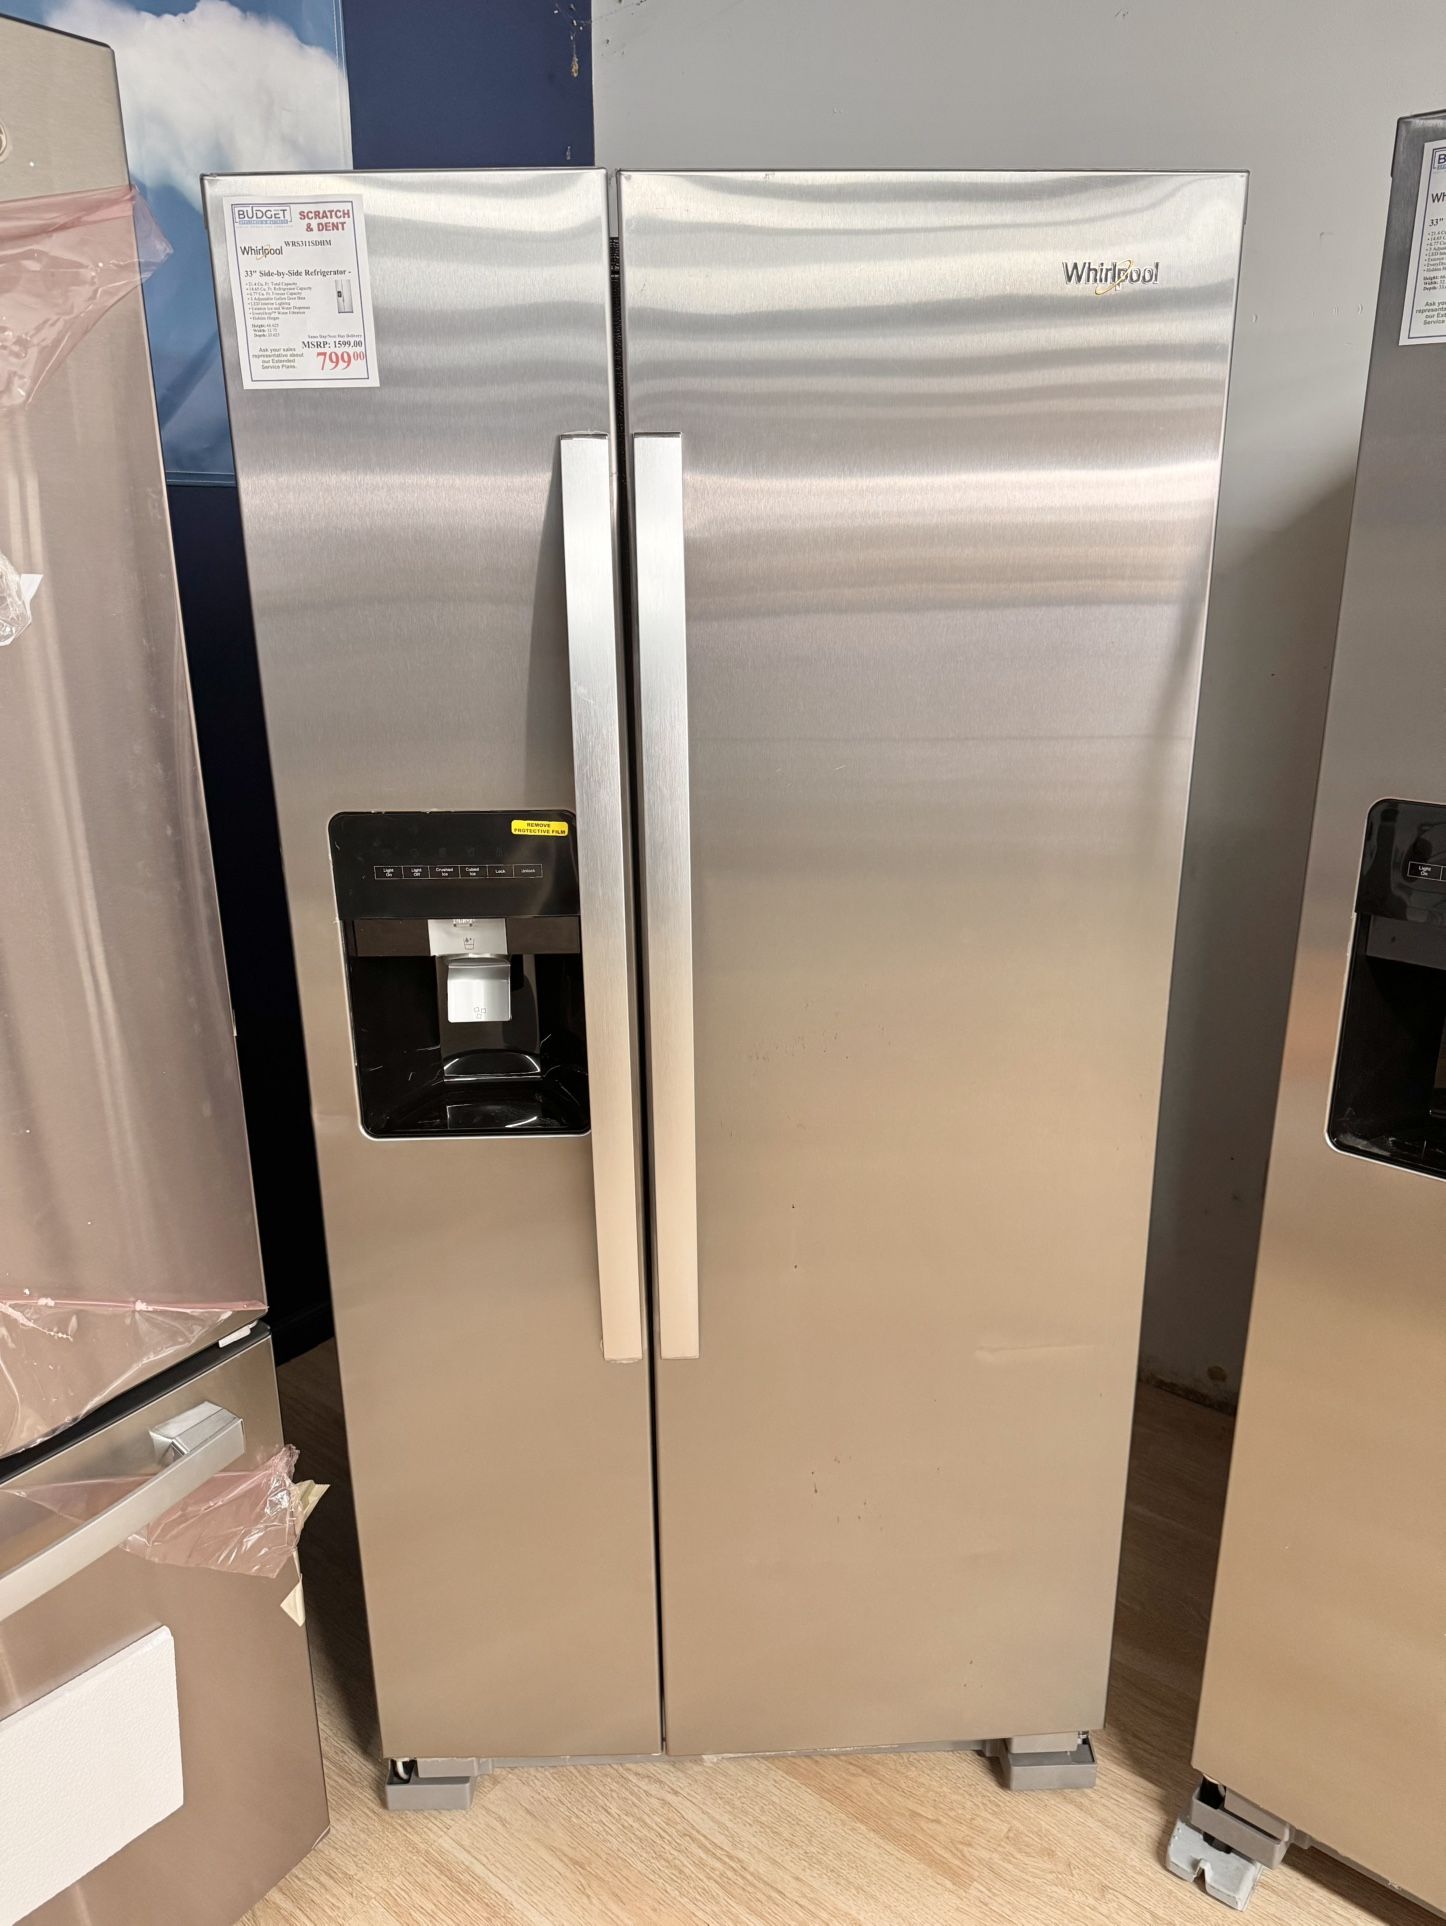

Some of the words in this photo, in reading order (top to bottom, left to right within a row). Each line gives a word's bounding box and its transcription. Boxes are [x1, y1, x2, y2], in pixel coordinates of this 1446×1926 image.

[237, 206, 287, 219] BUDGET
[299, 209, 350, 220] SCRATCH
[306, 223, 314, 232] &
[317, 222, 346, 231] DENT
[1429, 218, 1443, 227] 33"
[240, 246, 283, 258] Whirlpool
[259, 270, 302, 278] Side-by-Side
[304, 269, 346, 278] Refrigerator
[1062, 261, 1159, 291] Whirlpool
[301, 340, 331, 349] MSRP:
[334, 340, 363, 348] 1599.00
